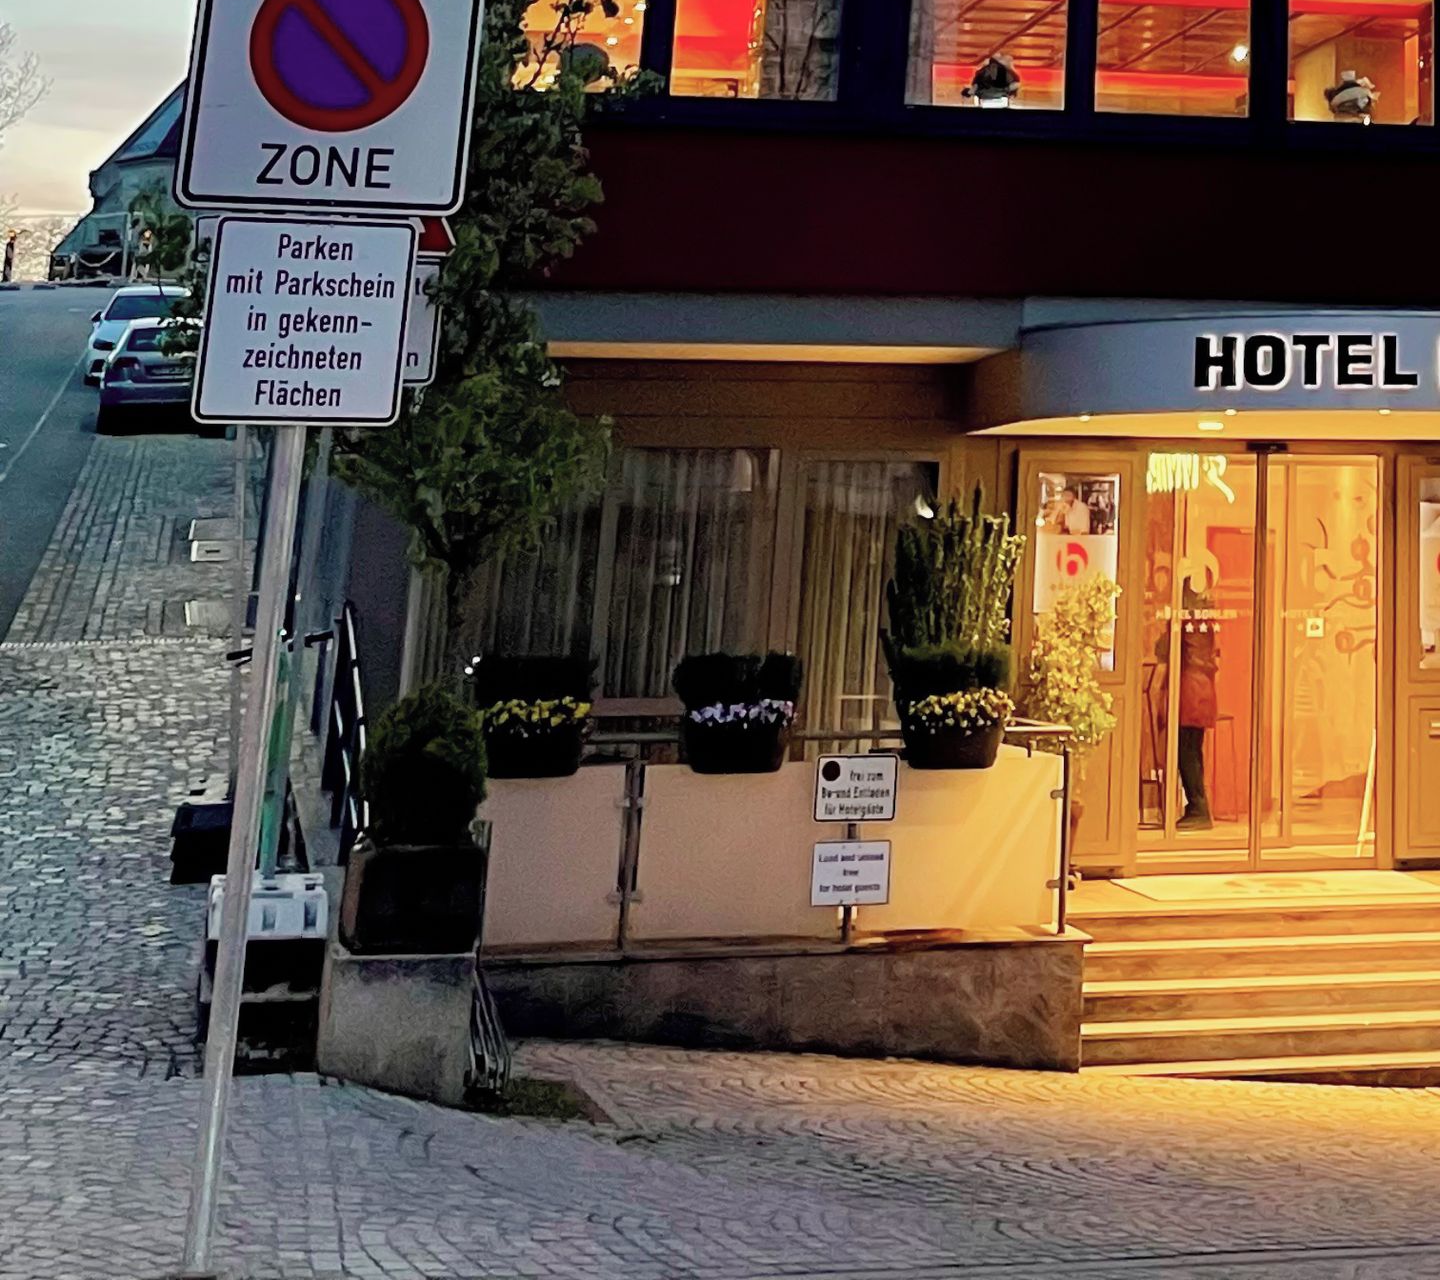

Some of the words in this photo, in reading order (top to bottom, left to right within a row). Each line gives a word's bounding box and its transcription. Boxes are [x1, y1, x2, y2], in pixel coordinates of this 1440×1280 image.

[256, 142, 395, 189] ZONE
[278, 233, 353, 261] Parken
[226, 268, 263, 295] mit
[275, 269, 395, 298] Parkschein
[247, 305, 267, 332] in
[278, 306, 373, 339] gekenn-
[243, 342, 363, 370] zeichneten
[1194, 334, 1419, 388] HOTEL
[255, 380, 341, 407] Flächen
